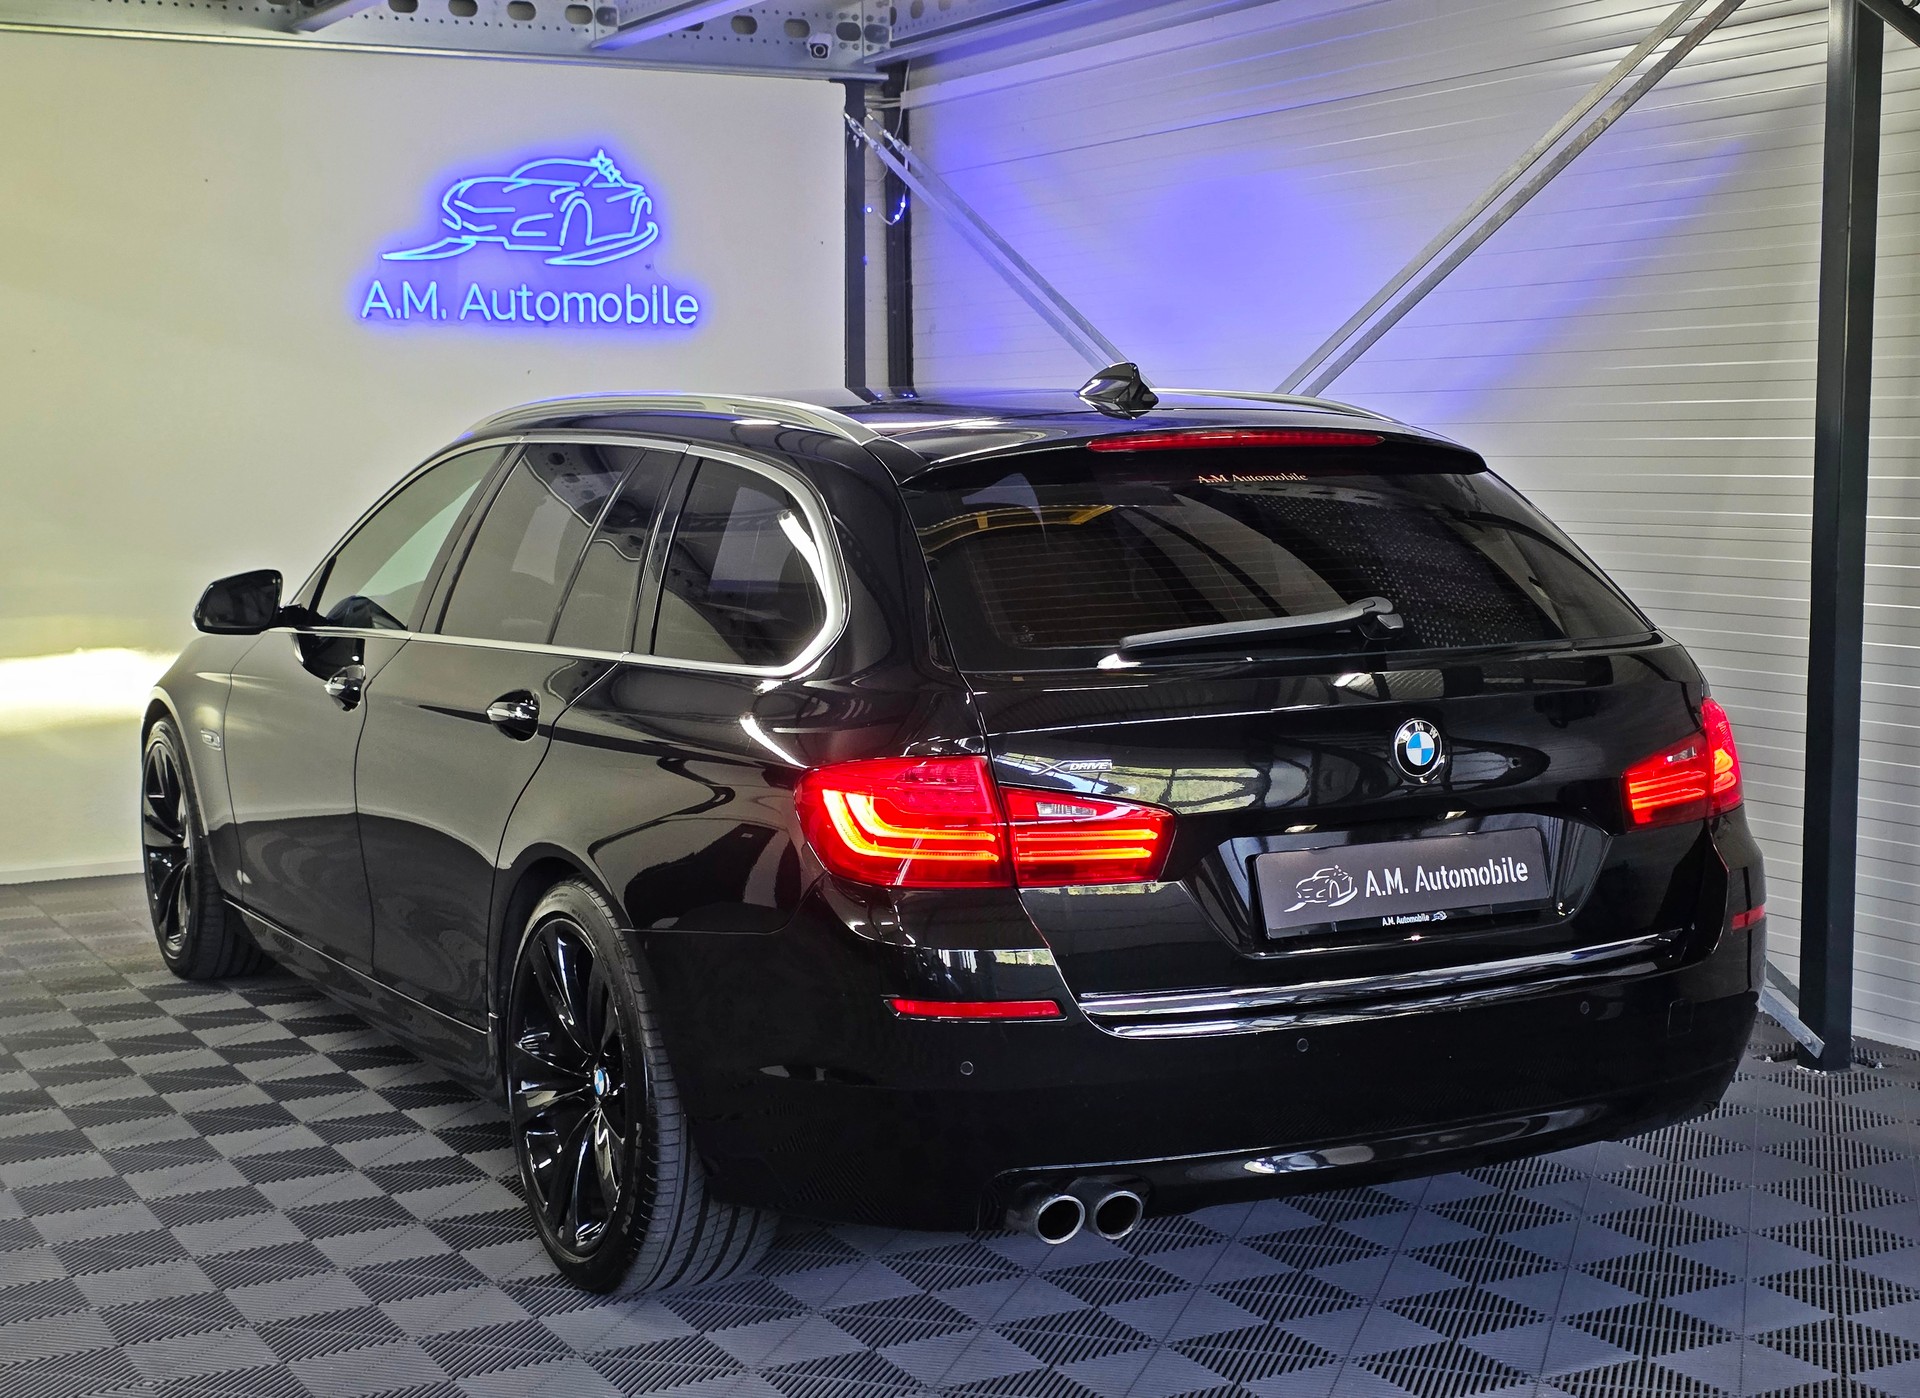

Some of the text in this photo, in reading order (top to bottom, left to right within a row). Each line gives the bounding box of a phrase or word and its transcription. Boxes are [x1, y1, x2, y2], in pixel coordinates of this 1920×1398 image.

[361, 280, 699, 324] A.M. Automobile
[1232, 472, 1308, 482] Automobile
[1399, 722, 1438, 742] BMW
[1365, 856, 1529, 898] A.M. Automobile
[1396, 913, 1430, 925] Automobile
